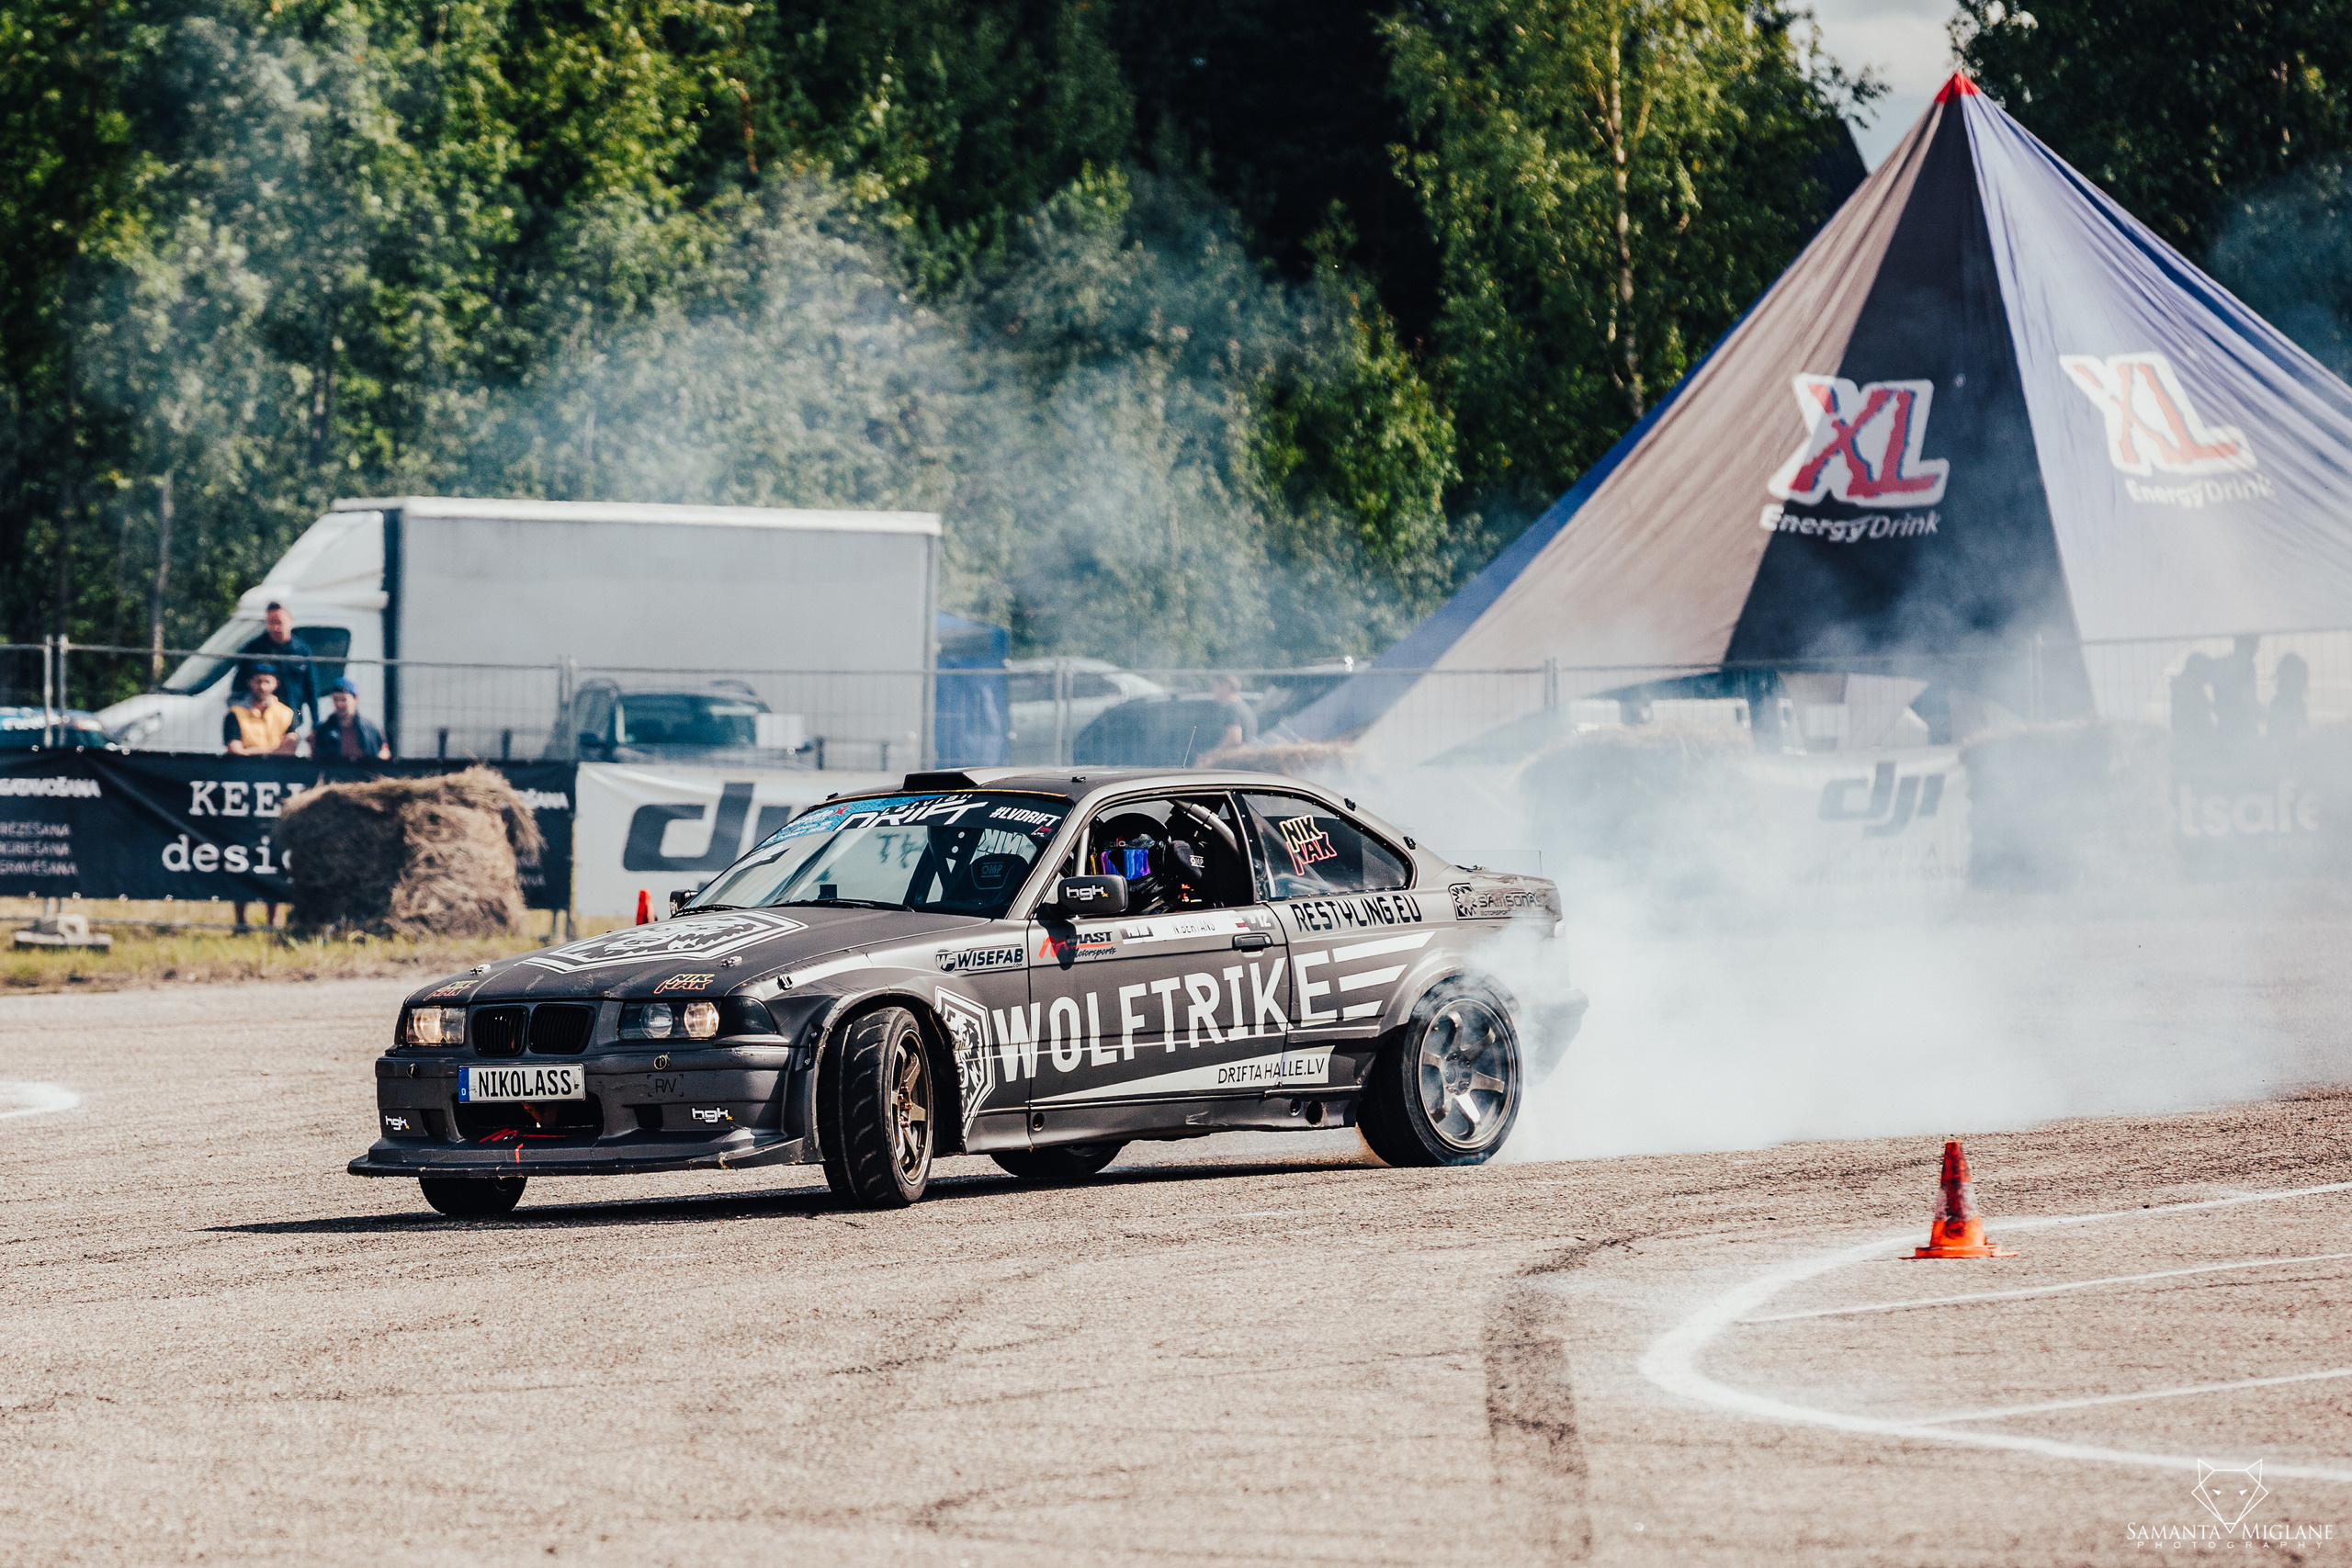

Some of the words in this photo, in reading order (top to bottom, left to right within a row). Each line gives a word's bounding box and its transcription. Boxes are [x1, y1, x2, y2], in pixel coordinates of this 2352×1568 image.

[2059, 353, 2258, 476] XL
[1770, 373, 1949, 506] XL
[1818, 760, 1946, 839] dji
[2178, 777, 2323, 838] tsafe
[989, 806, 1062, 828] #LVDRIFT
[1279, 815, 1323, 853] NIK
[1286, 831, 1338, 876] NAK
[981, 863, 1003, 875] OMP
[1066, 884, 1104, 901] hgk
[1289, 894, 1423, 932] RESTYLING.EU
[957, 948, 1023, 968] WISEFAB
[653, 979, 714, 994] NAK
[665, 974, 716, 986] NIK
[992, 950, 1339, 1083] WOLFTRIKE
[478, 1069, 572, 1097] NIKOLASS
[385, 1114, 408, 1130] hgk
[691, 1107, 729, 1123] hgk
